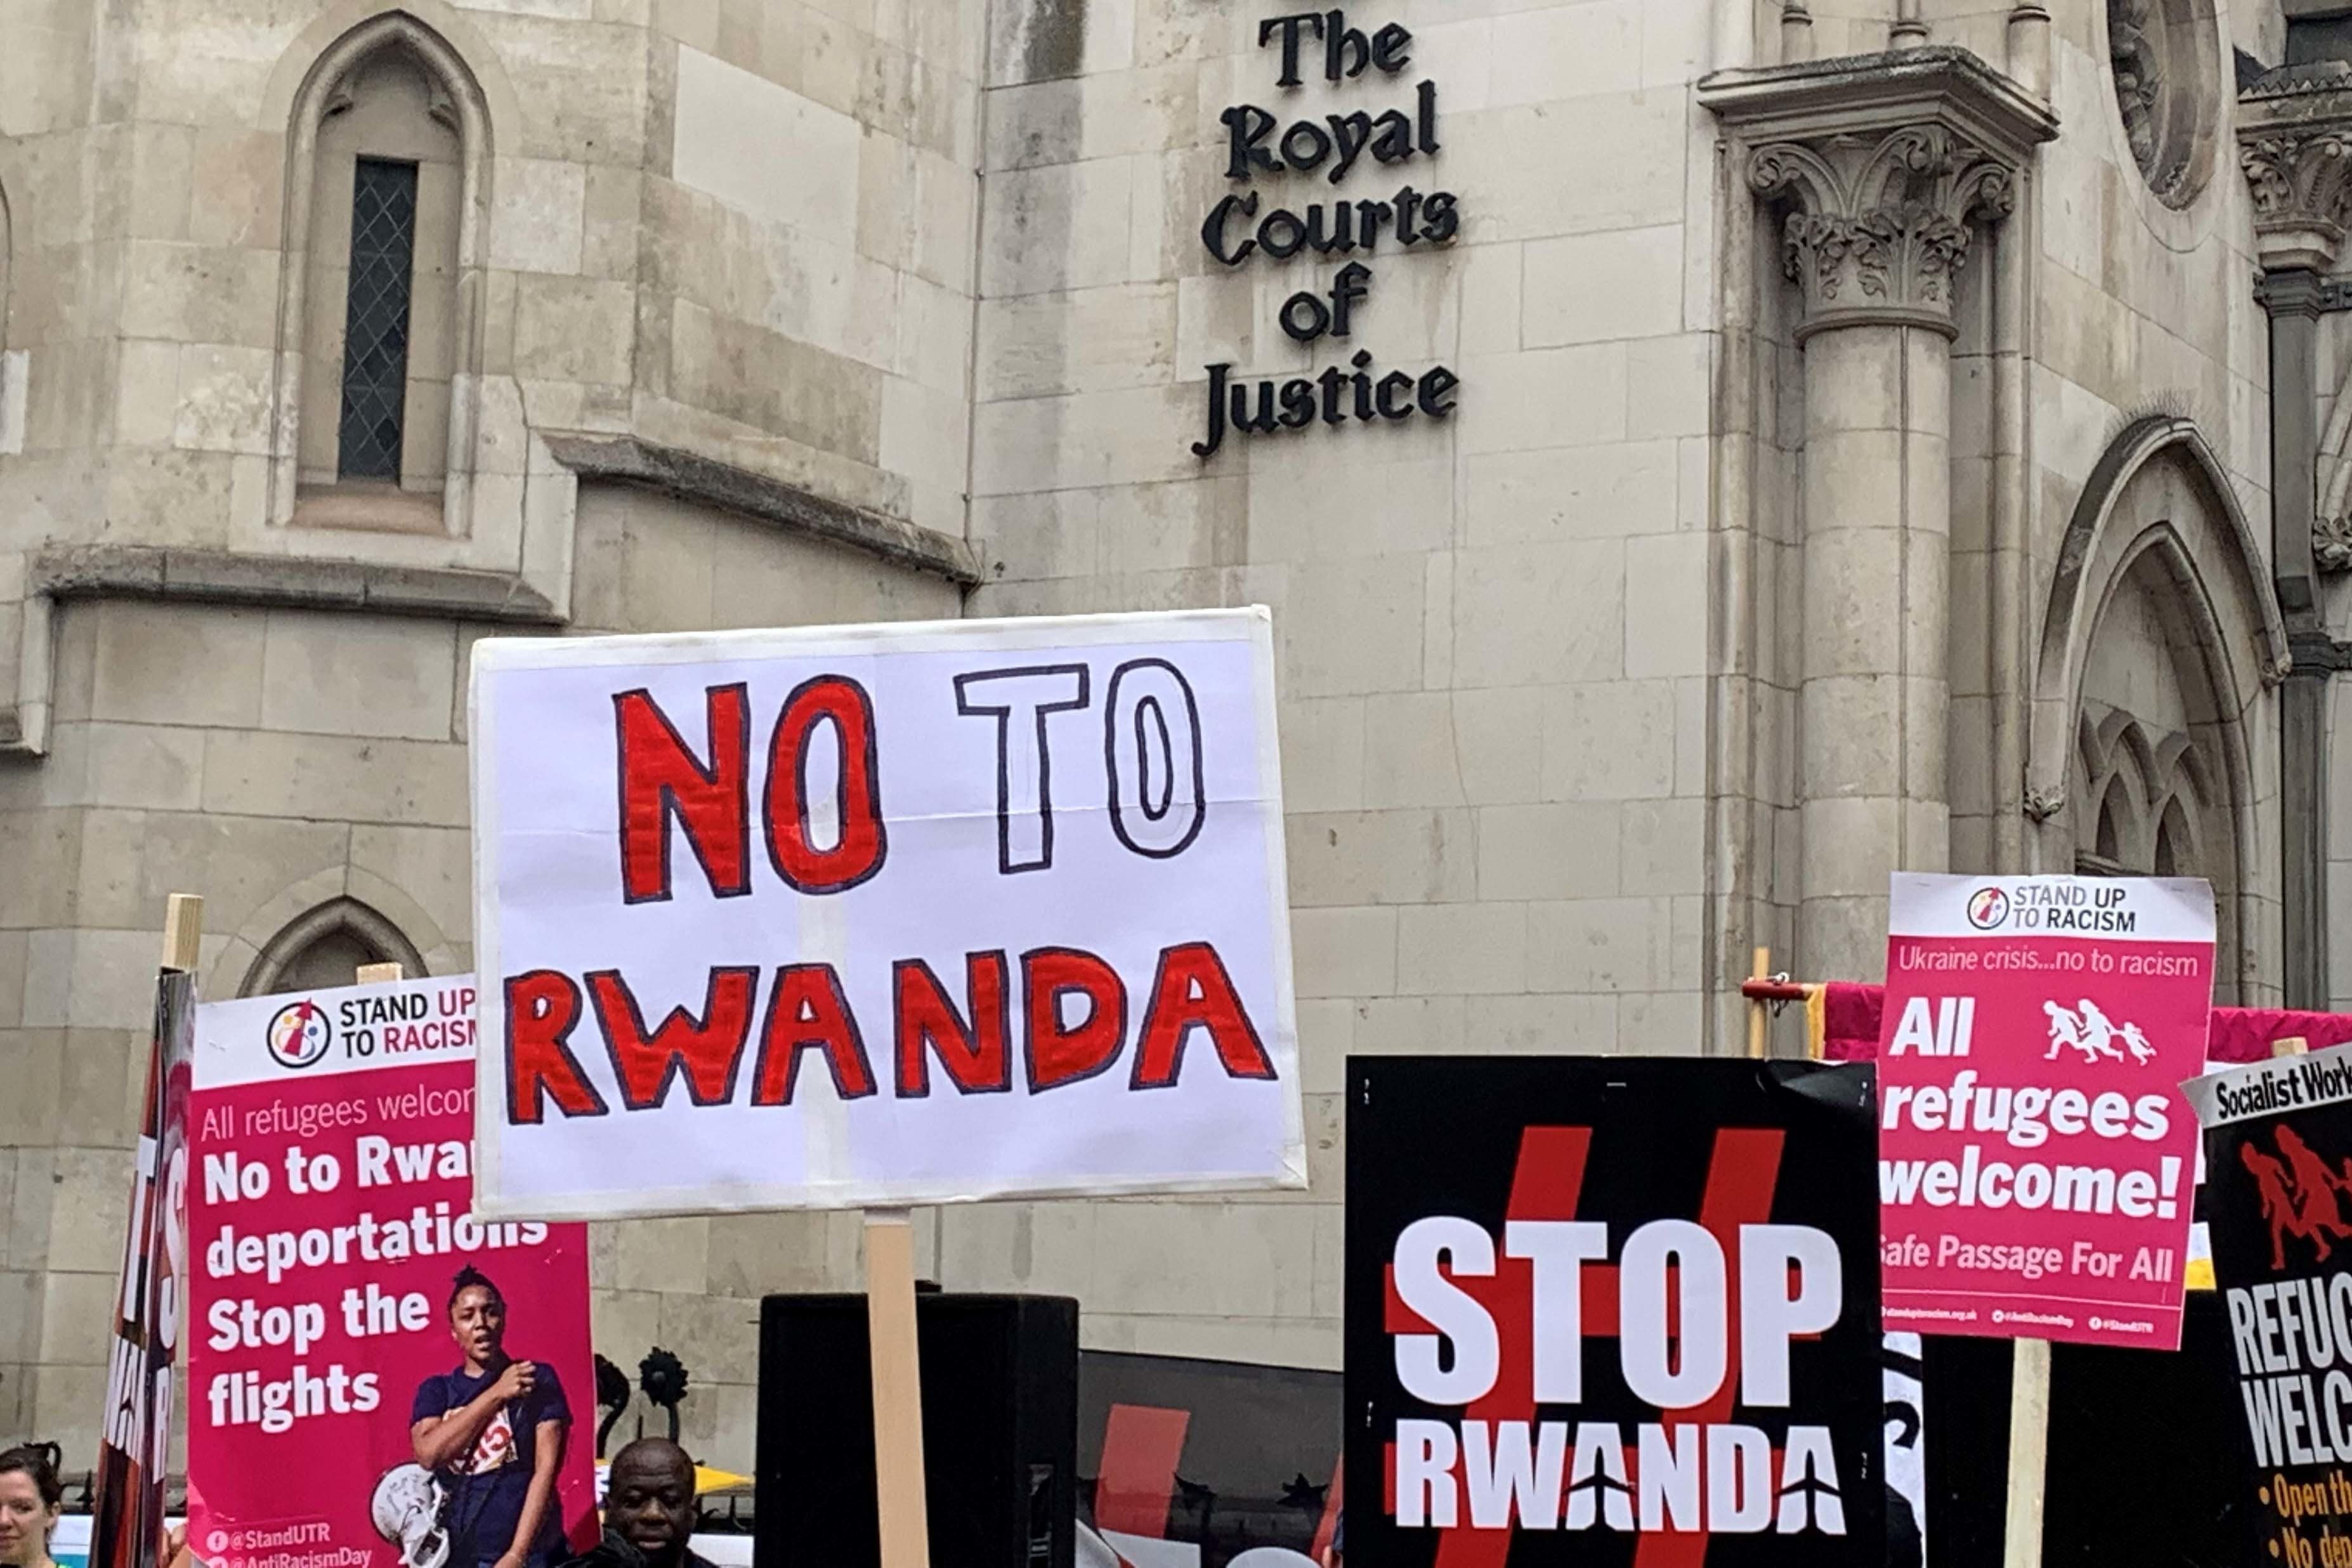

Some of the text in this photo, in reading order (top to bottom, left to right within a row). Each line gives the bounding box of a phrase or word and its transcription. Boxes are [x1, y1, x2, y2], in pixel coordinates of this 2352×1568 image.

[1258, 9, 1411, 88] The
[1220, 79, 1440, 184] Royal
[1201, 185, 1459, 266] Courts
[1279, 261, 1373, 341] of
[1191, 349, 1460, 456] Justice
[611, 658, 1205, 905] NO TO
[2013, 885, 2126, 909] STAND UP
[2014, 908, 2136, 932] TO RACISM
[1898, 945, 1978, 971] Ukraine
[2091, 948, 2114, 973] to
[2120, 952, 2198, 977] racism
[340, 988, 476, 1028] STAND UP
[504, 941, 1279, 1125] RWANDA
[1888, 997, 1975, 1057] All
[341, 1029, 374, 1058] TO
[201, 1106, 233, 1142] All
[245, 1098, 367, 1139] refugees
[1882, 1069, 2170, 1148] refugees
[2216, 1069, 2304, 1120] Socialist
[203, 1135, 474, 1205] No to Rwa
[1878, 1145, 2182, 1219] welcome!
[1937, 1235, 2063, 1279] Passage
[2071, 1241, 2122, 1279] For
[2129, 1247, 2173, 1282] All
[207, 1283, 430, 1356] Stop the
[1394, 1215, 1843, 1409] STOP
[208, 1364, 380, 1434] flights
[1396, 1418, 1847, 1536] RWANDA
[2273, 1473, 2330, 1527] Open
[231, 1523, 330, 1550] @StandUTR
[2282, 1526, 2314, 1568] No
